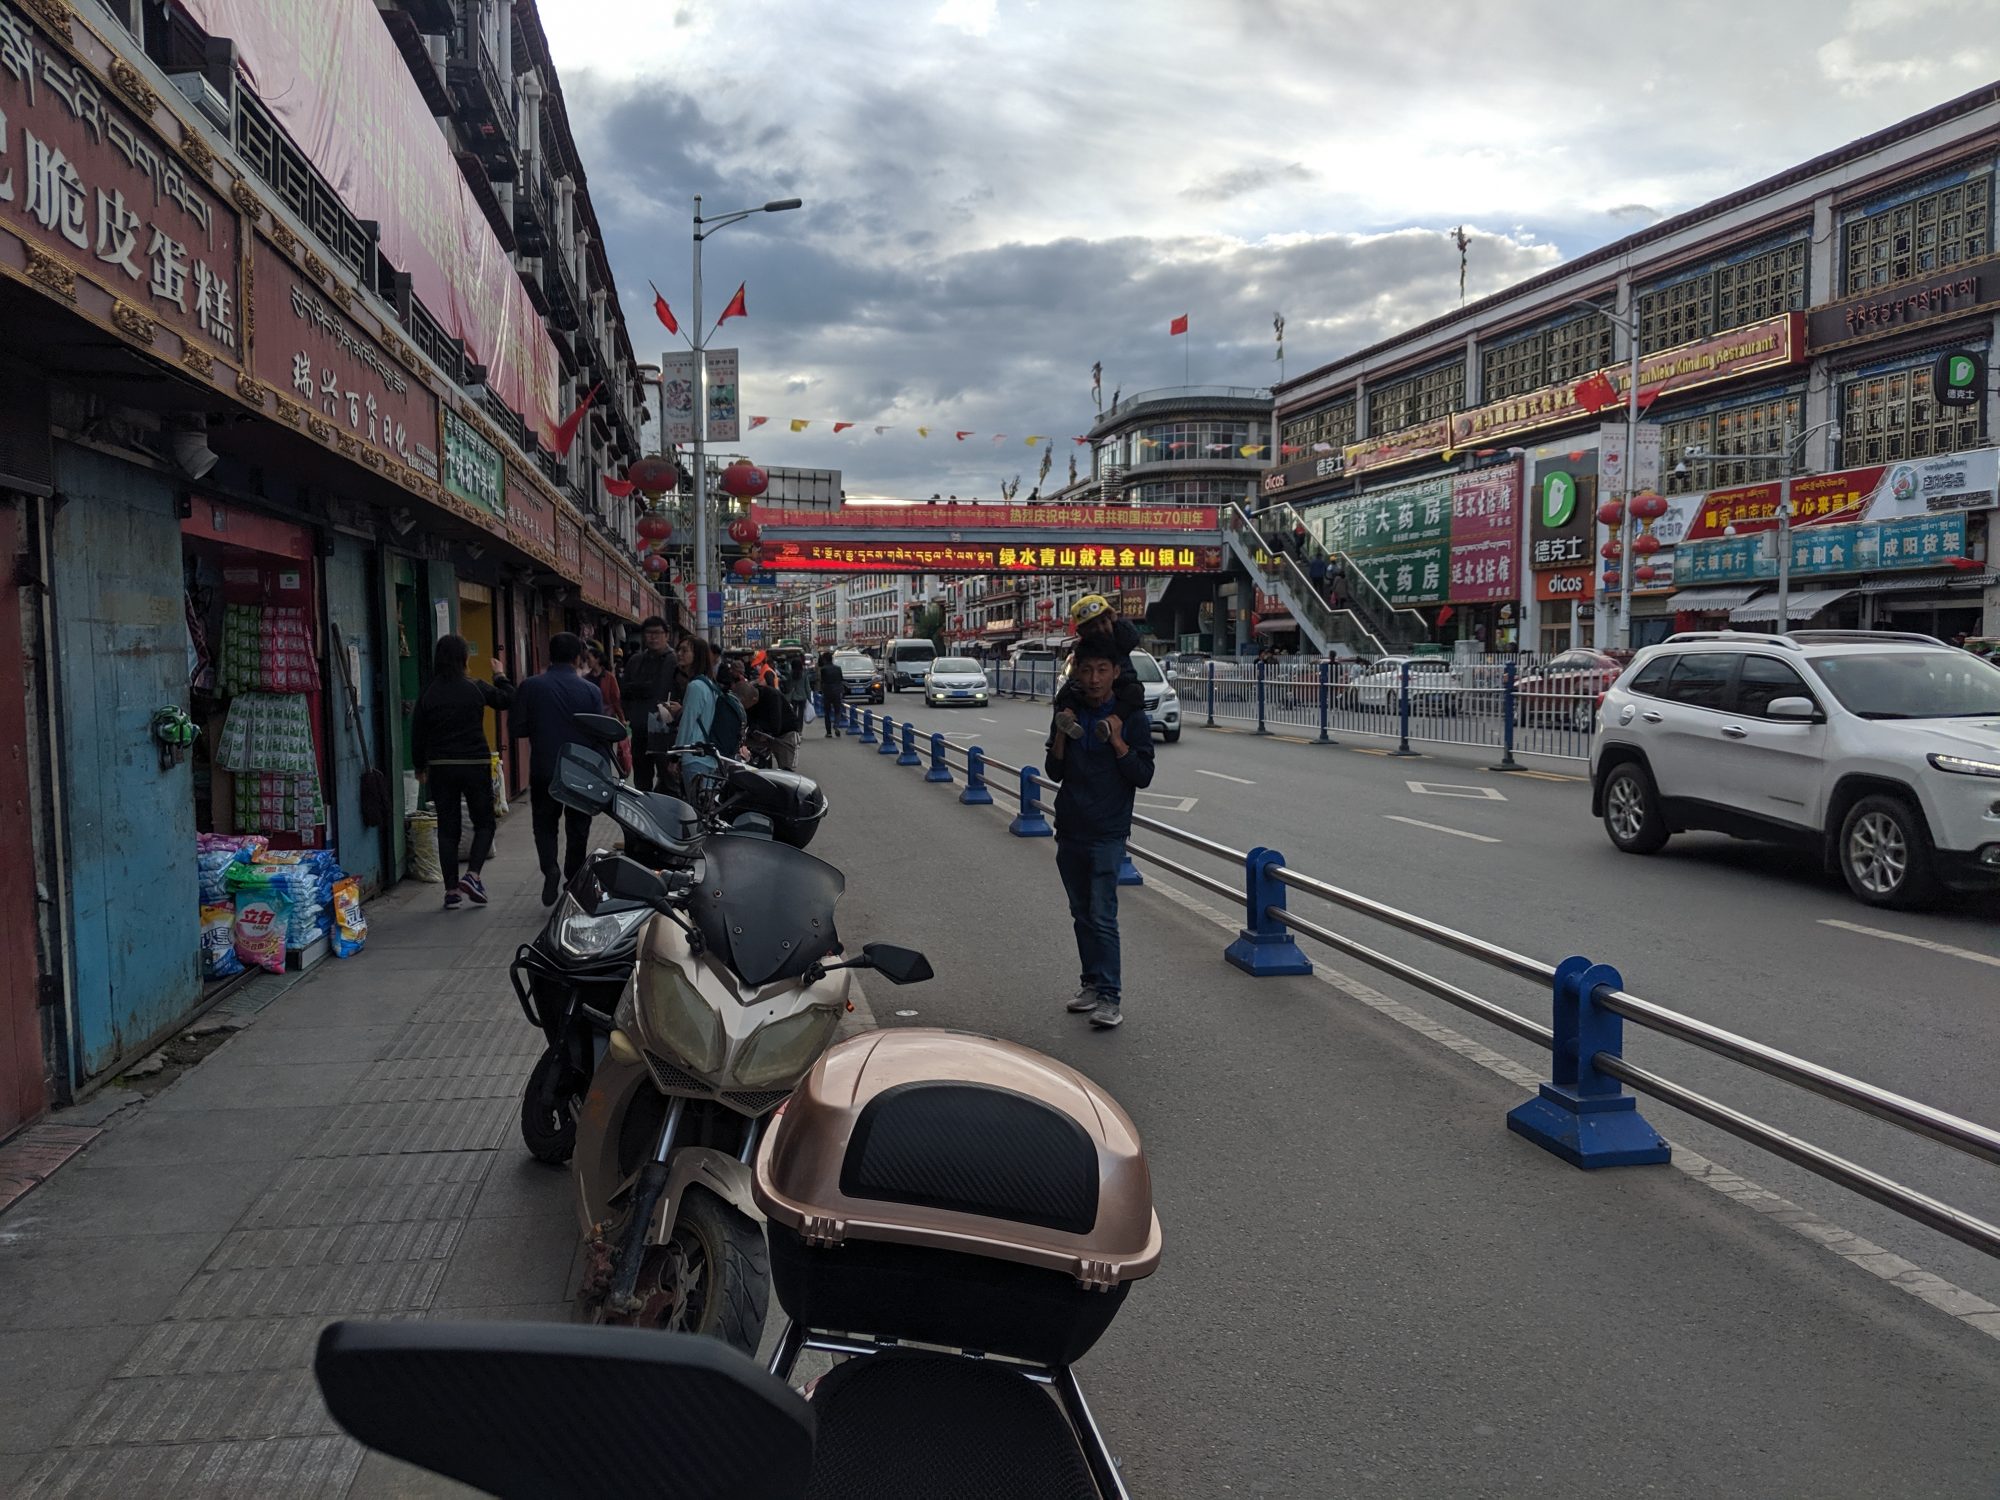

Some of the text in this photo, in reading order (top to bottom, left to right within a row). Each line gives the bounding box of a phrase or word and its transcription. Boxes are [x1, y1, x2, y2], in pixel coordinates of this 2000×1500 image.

[1618, 366, 1651, 391] Tiban
[1715, 336, 1773, 365] Restaurant
[1947, 388, 1975, 400] 德克士
[292, 349, 409, 460] 瑞兴百货日化
[1316, 453, 1344, 477] 德克士
[1264, 473, 1285, 490] dicos
[1009, 507, 1204, 526] 热烈庆祝中华人民共和国成立70周年
[999, 547, 1196, 567] 绿水青山就是金山银山
[1534, 535, 1583, 562] 德克士
[1548, 573, 1583, 593] dicos
[240, 909, 276, 925] 立白
